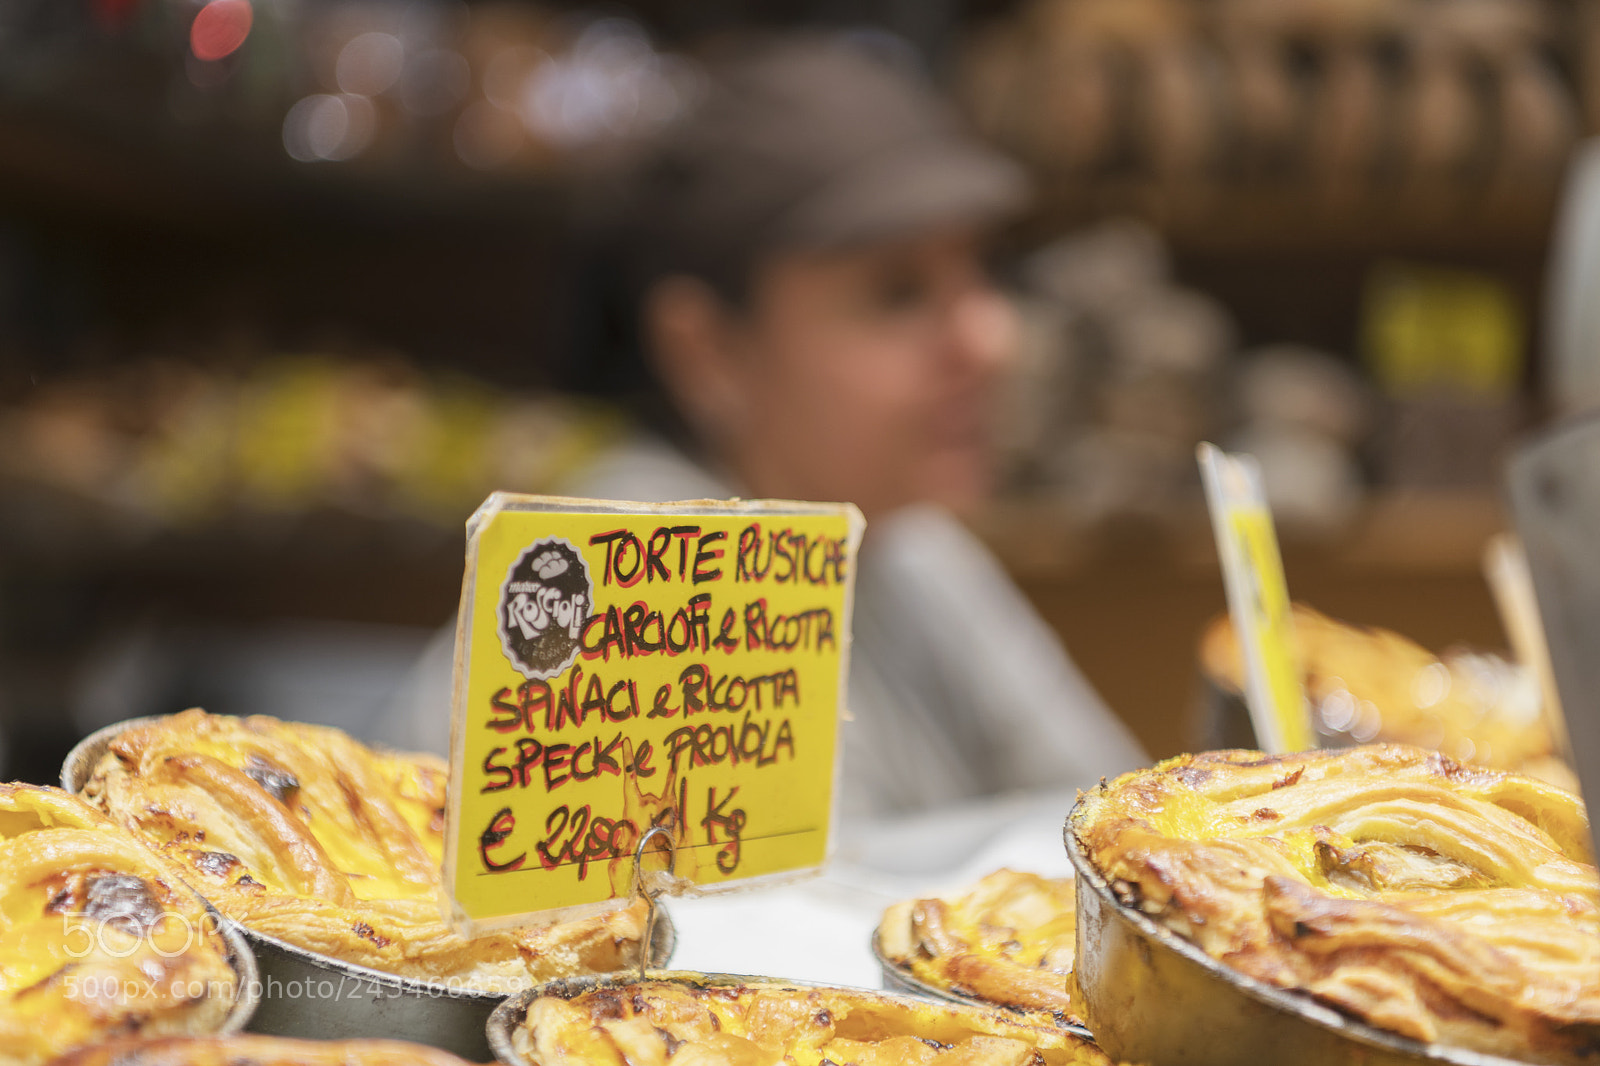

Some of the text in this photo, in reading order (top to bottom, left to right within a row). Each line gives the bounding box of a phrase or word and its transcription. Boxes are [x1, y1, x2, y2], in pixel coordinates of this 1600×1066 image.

[589, 523, 846, 588] TORTE RUSTICHE
[578, 593, 836, 663] CARCIOFI e RICOTTA
[486, 663, 800, 733] SPINACI e RICOTTA
[480, 710, 795, 794] SPECK e PROVOLA
